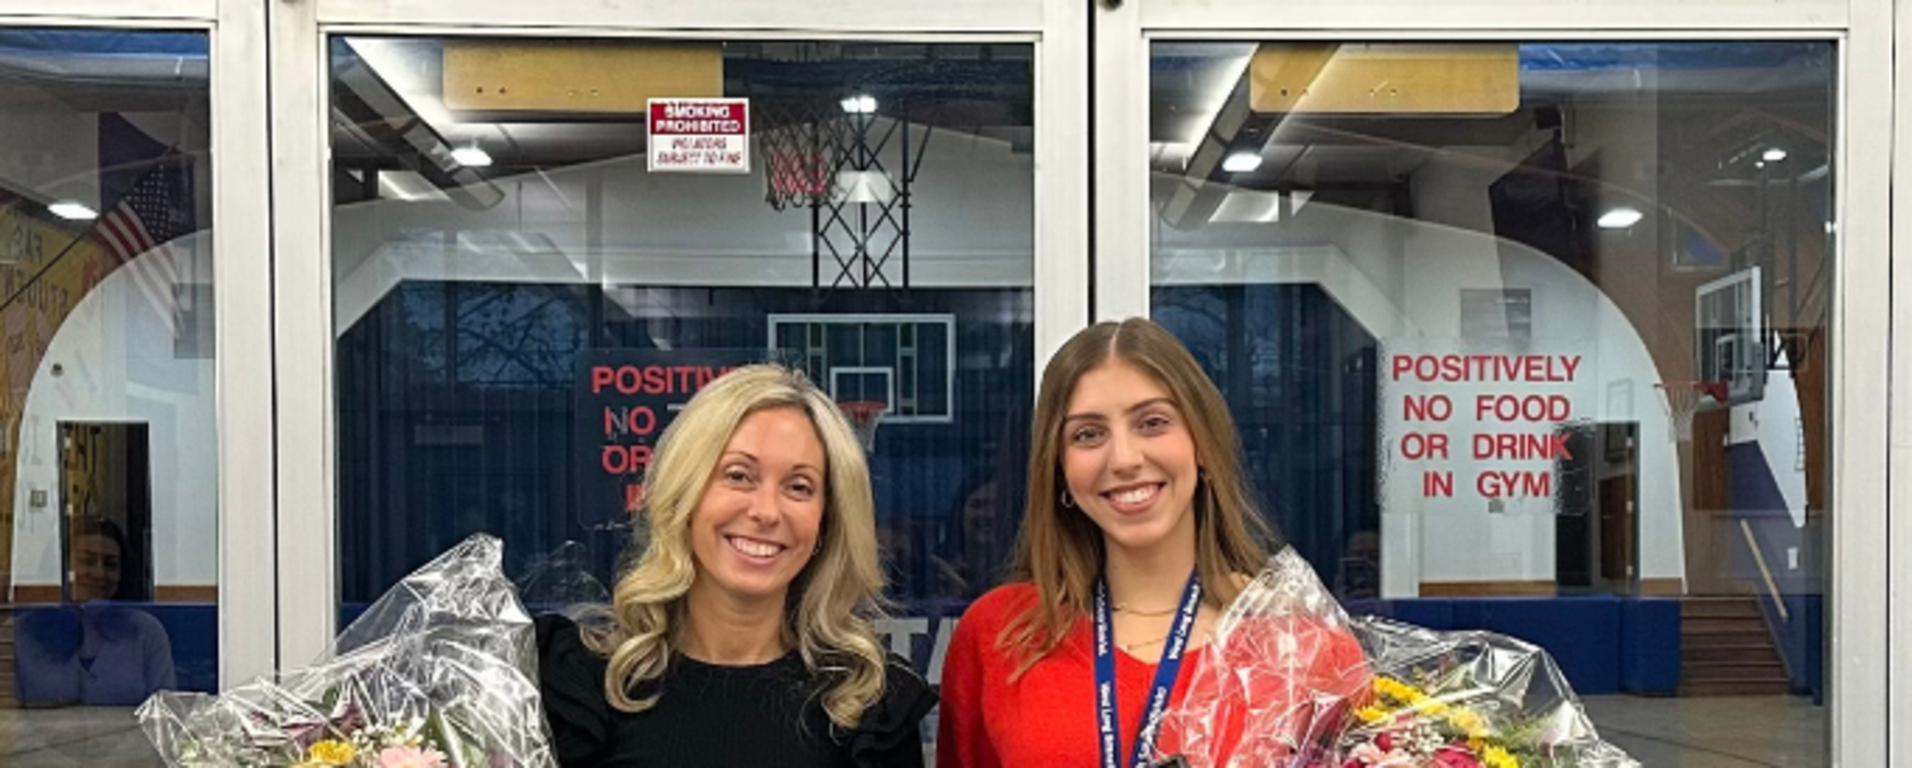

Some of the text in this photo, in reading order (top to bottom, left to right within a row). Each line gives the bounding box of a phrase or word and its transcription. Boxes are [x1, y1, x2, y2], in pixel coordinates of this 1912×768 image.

[656, 120, 741, 133] PROHIBITED
[664, 106, 730, 119] SMOKING
[592, 366, 735, 395] POSITIV
[1392, 355, 1582, 382] POSITIVELY
[604, 405, 657, 435] NO
[1403, 394, 1571, 422] NO FOOD
[602, 445, 652, 474] OR
[1400, 432, 1573, 460] OR DRINK
[1423, 470, 1550, 498] IN GYM
